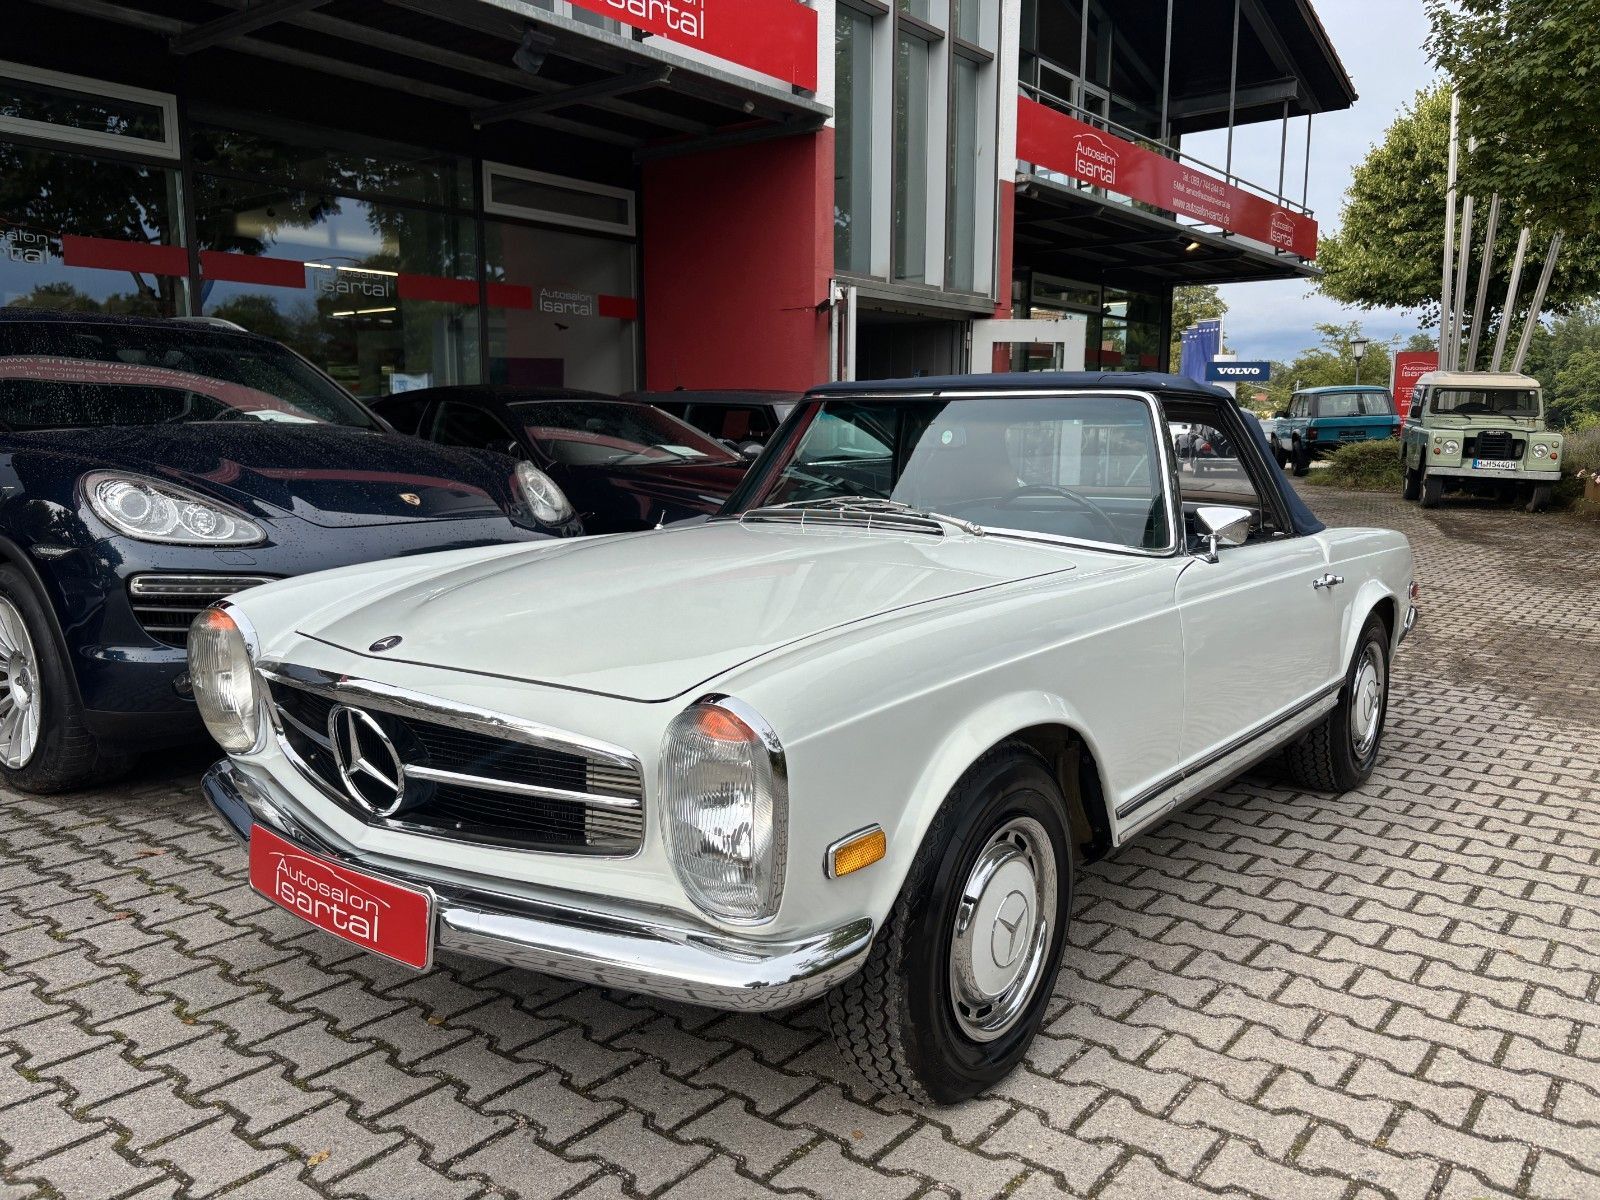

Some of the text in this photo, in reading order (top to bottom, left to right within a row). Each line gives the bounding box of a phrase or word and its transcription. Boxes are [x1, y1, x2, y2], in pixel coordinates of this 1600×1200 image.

[598, 0, 704, 39] artal
[1076, 141, 1116, 166] Autosalon
[1075, 152, 1116, 185] Isartal
[1271, 226, 1294, 247] Isartal
[1272, 218, 1294, 233] Autosalon
[317, 273, 390, 298] Isartal
[541, 288, 592, 304] Autosalon
[540, 296, 592, 317] Isartal
[1217, 367, 1260, 375] VOLVO
[1401, 369, 1425, 377] Isar
[277, 858, 379, 916] Autosalon
[275, 870, 379, 943] Isartal
